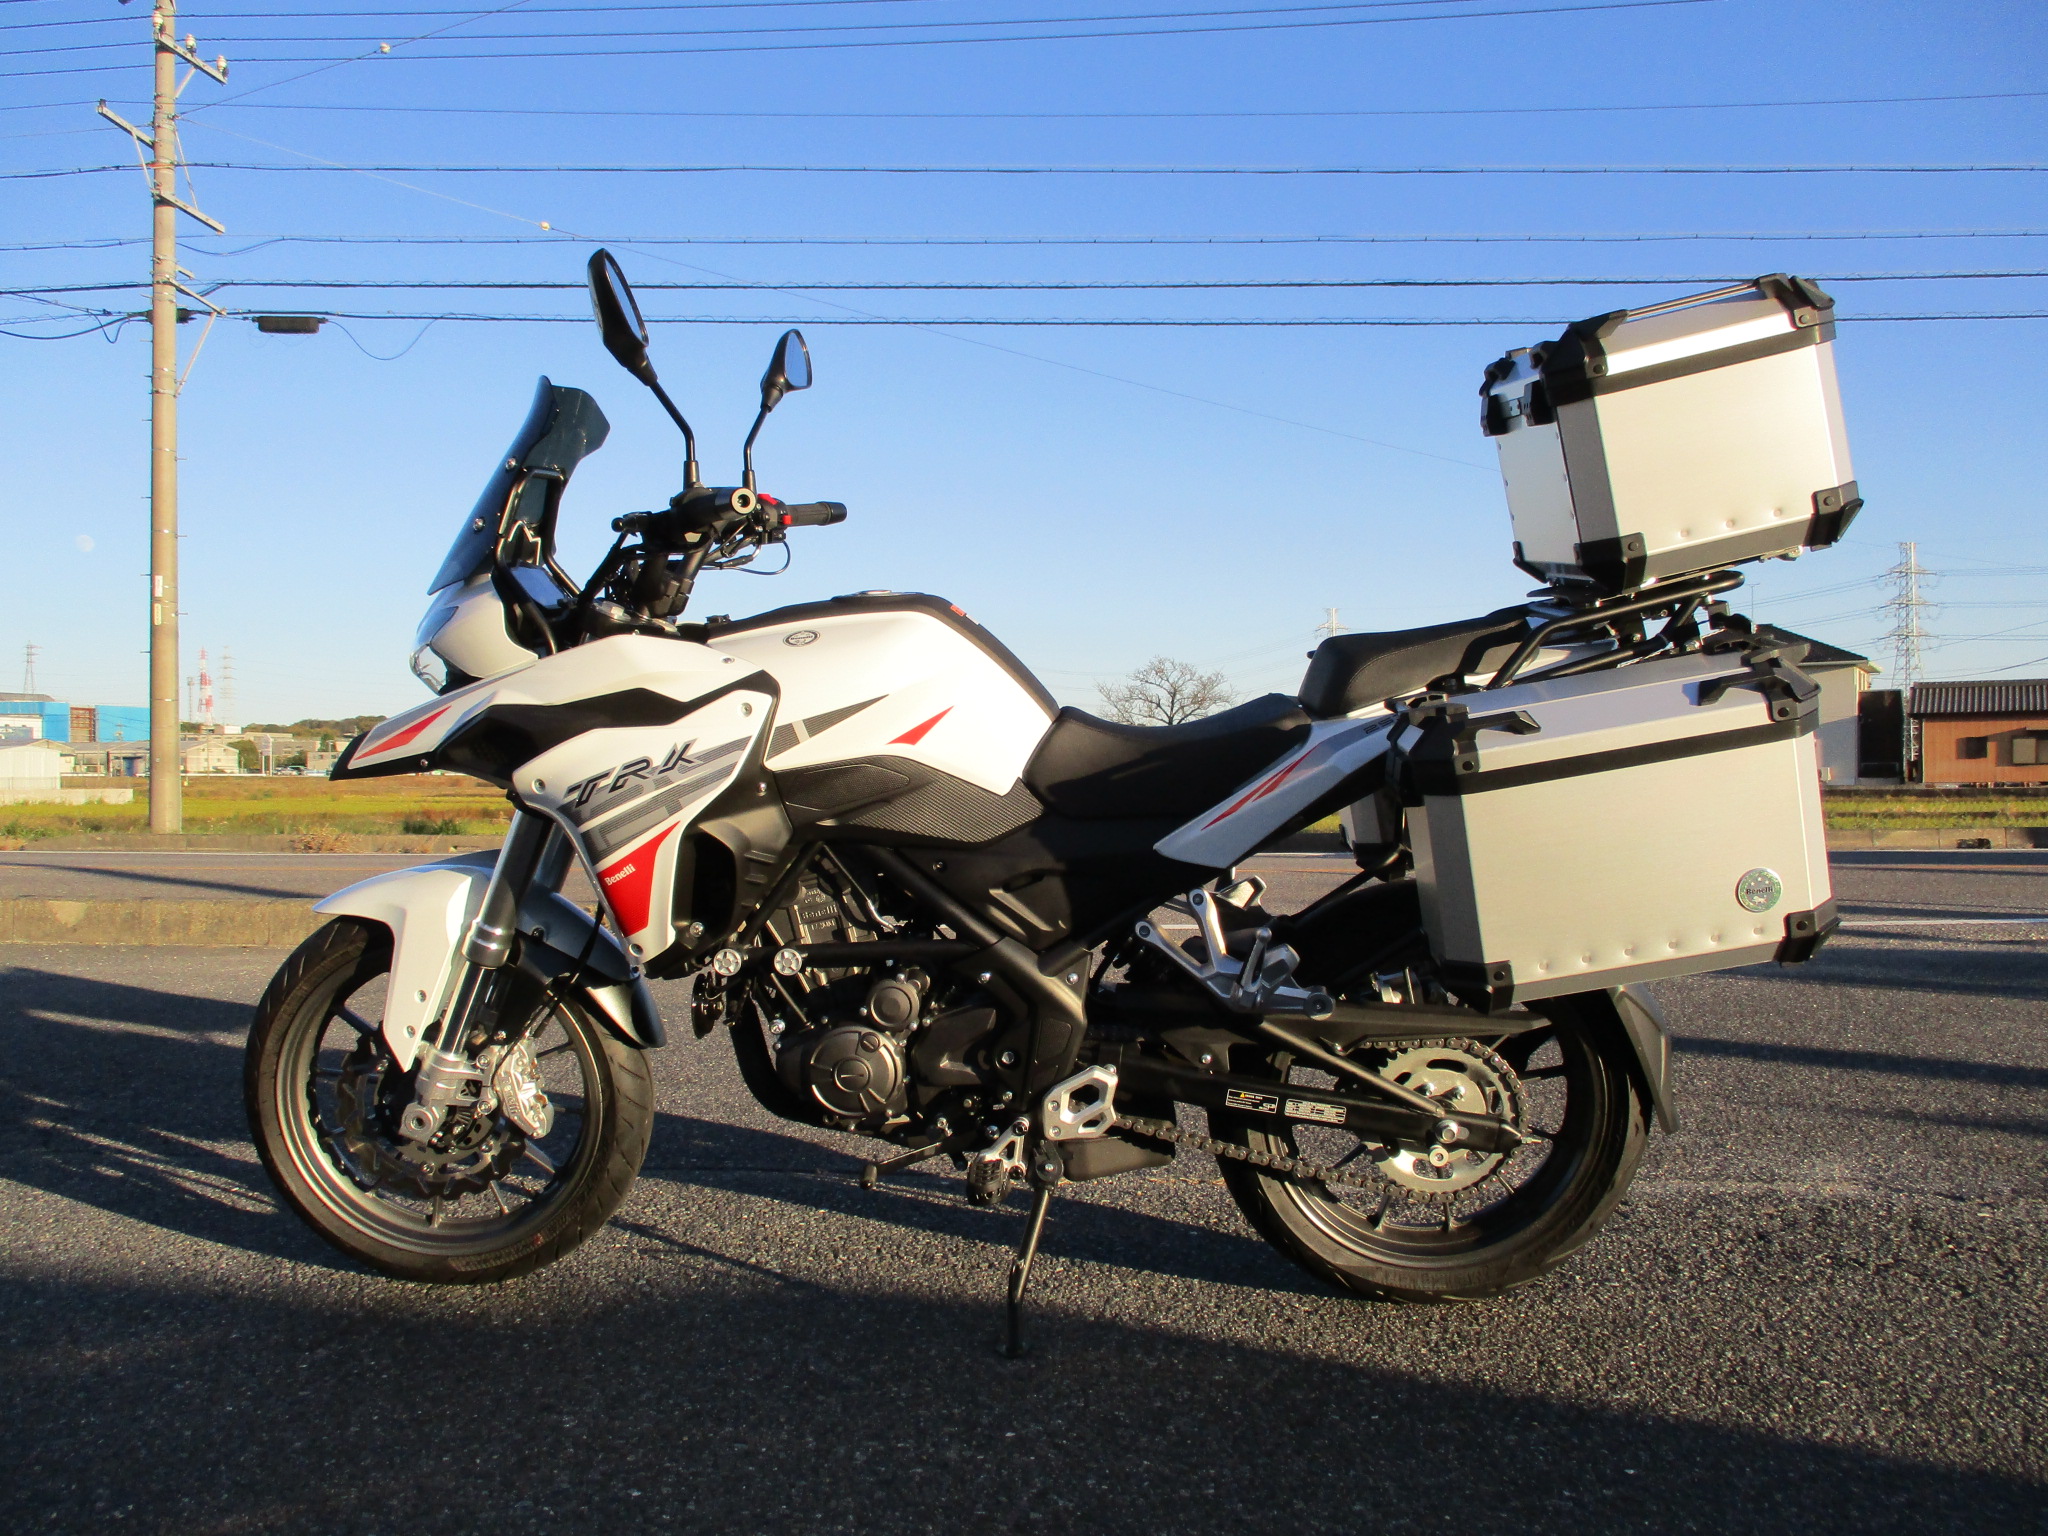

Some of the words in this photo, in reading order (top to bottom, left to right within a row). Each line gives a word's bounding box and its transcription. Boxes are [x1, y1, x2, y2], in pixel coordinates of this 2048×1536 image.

[1363, 714, 1397, 735] 25
[564, 739, 699, 809] TRK
[604, 863, 636, 886] Benelli
[1746, 886, 1773, 895] Benelli
